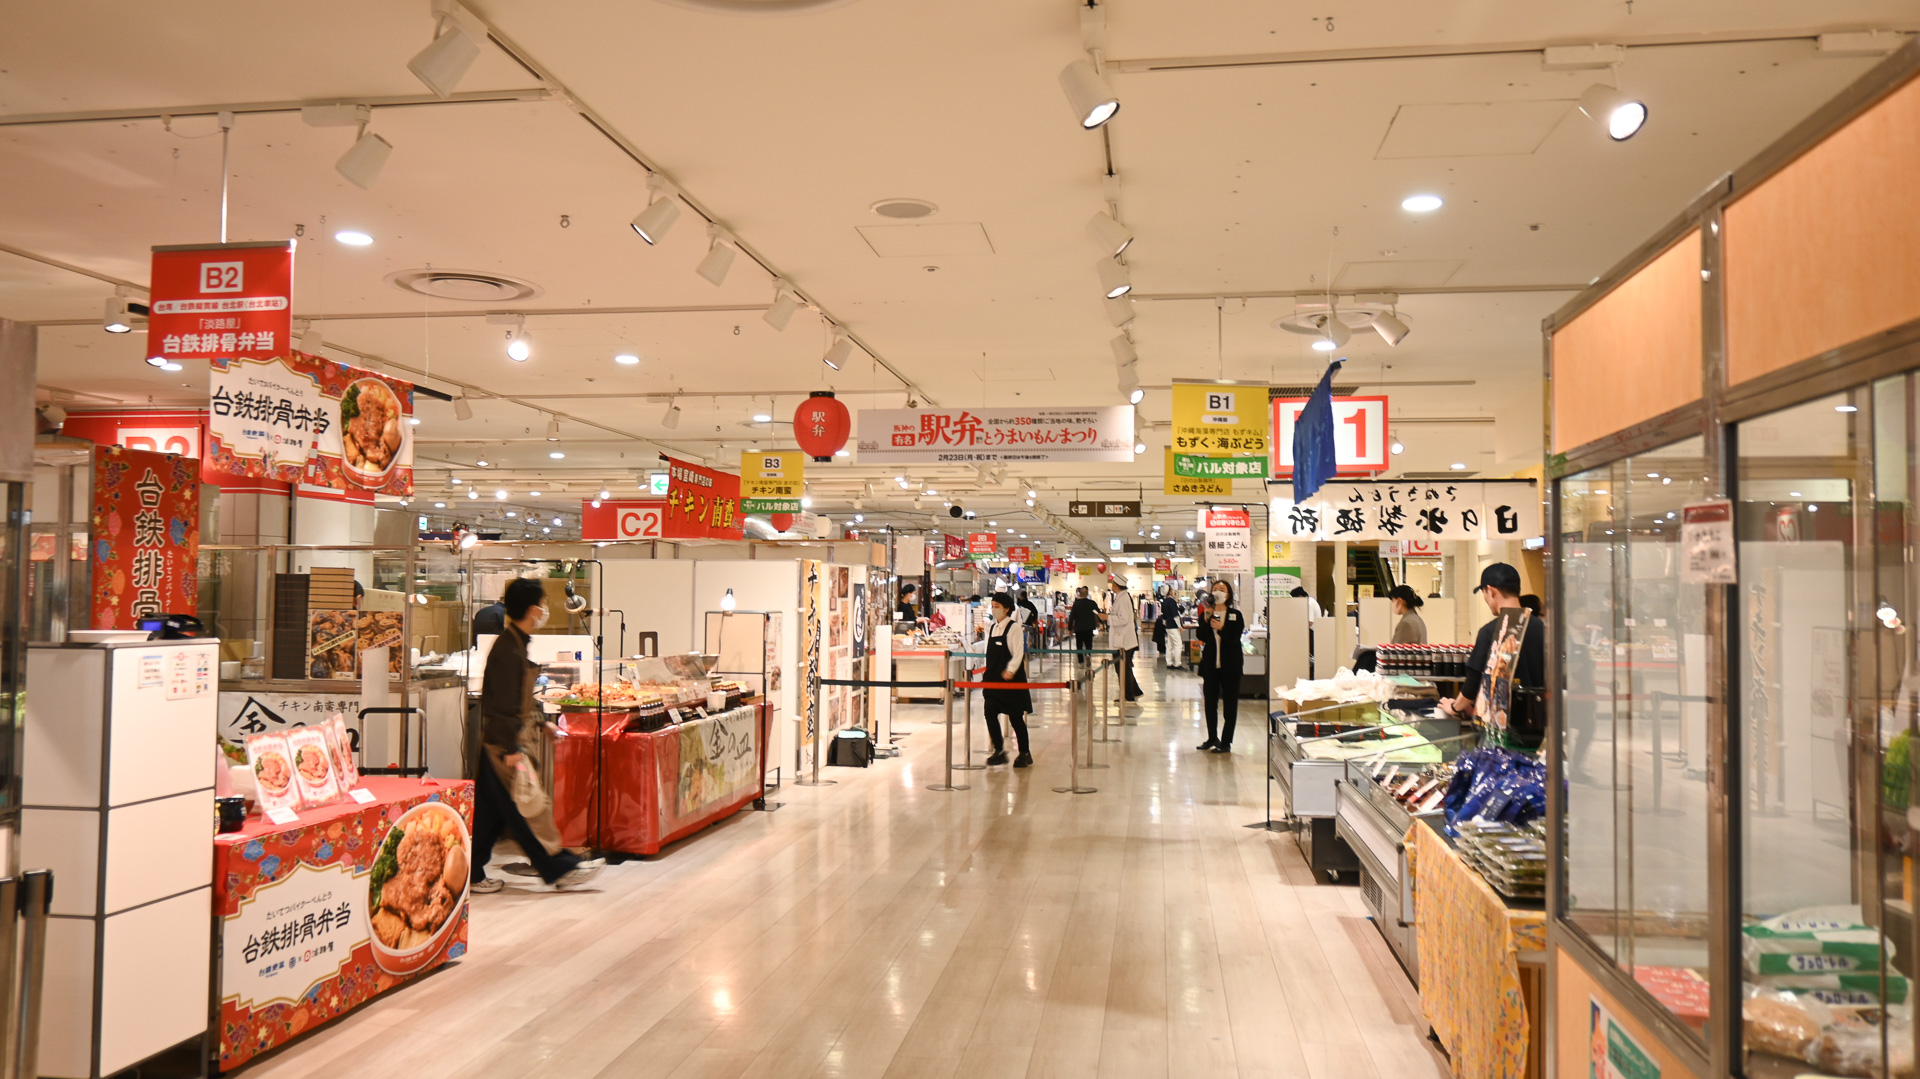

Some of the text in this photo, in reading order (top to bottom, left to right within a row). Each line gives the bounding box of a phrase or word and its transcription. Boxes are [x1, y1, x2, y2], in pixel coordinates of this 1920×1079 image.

[206, 267, 238, 289] B2
[162, 331, 275, 353] 台鉄排骨弁当
[212, 385, 330, 434] 台鉄排骨弁当
[1209, 395, 1230, 410] B1
[811, 411, 826, 437] 駅弁
[895, 434, 913, 446] 有名
[1176, 436, 1264, 449] もずく・海ぶどう
[765, 459, 780, 468] B3
[1197, 462, 1262, 474] バル対象店
[1173, 485, 1223, 493] さぬきうどん
[621, 512, 659, 536] C2
[242, 901, 351, 963] 台鉄排骨弁当
